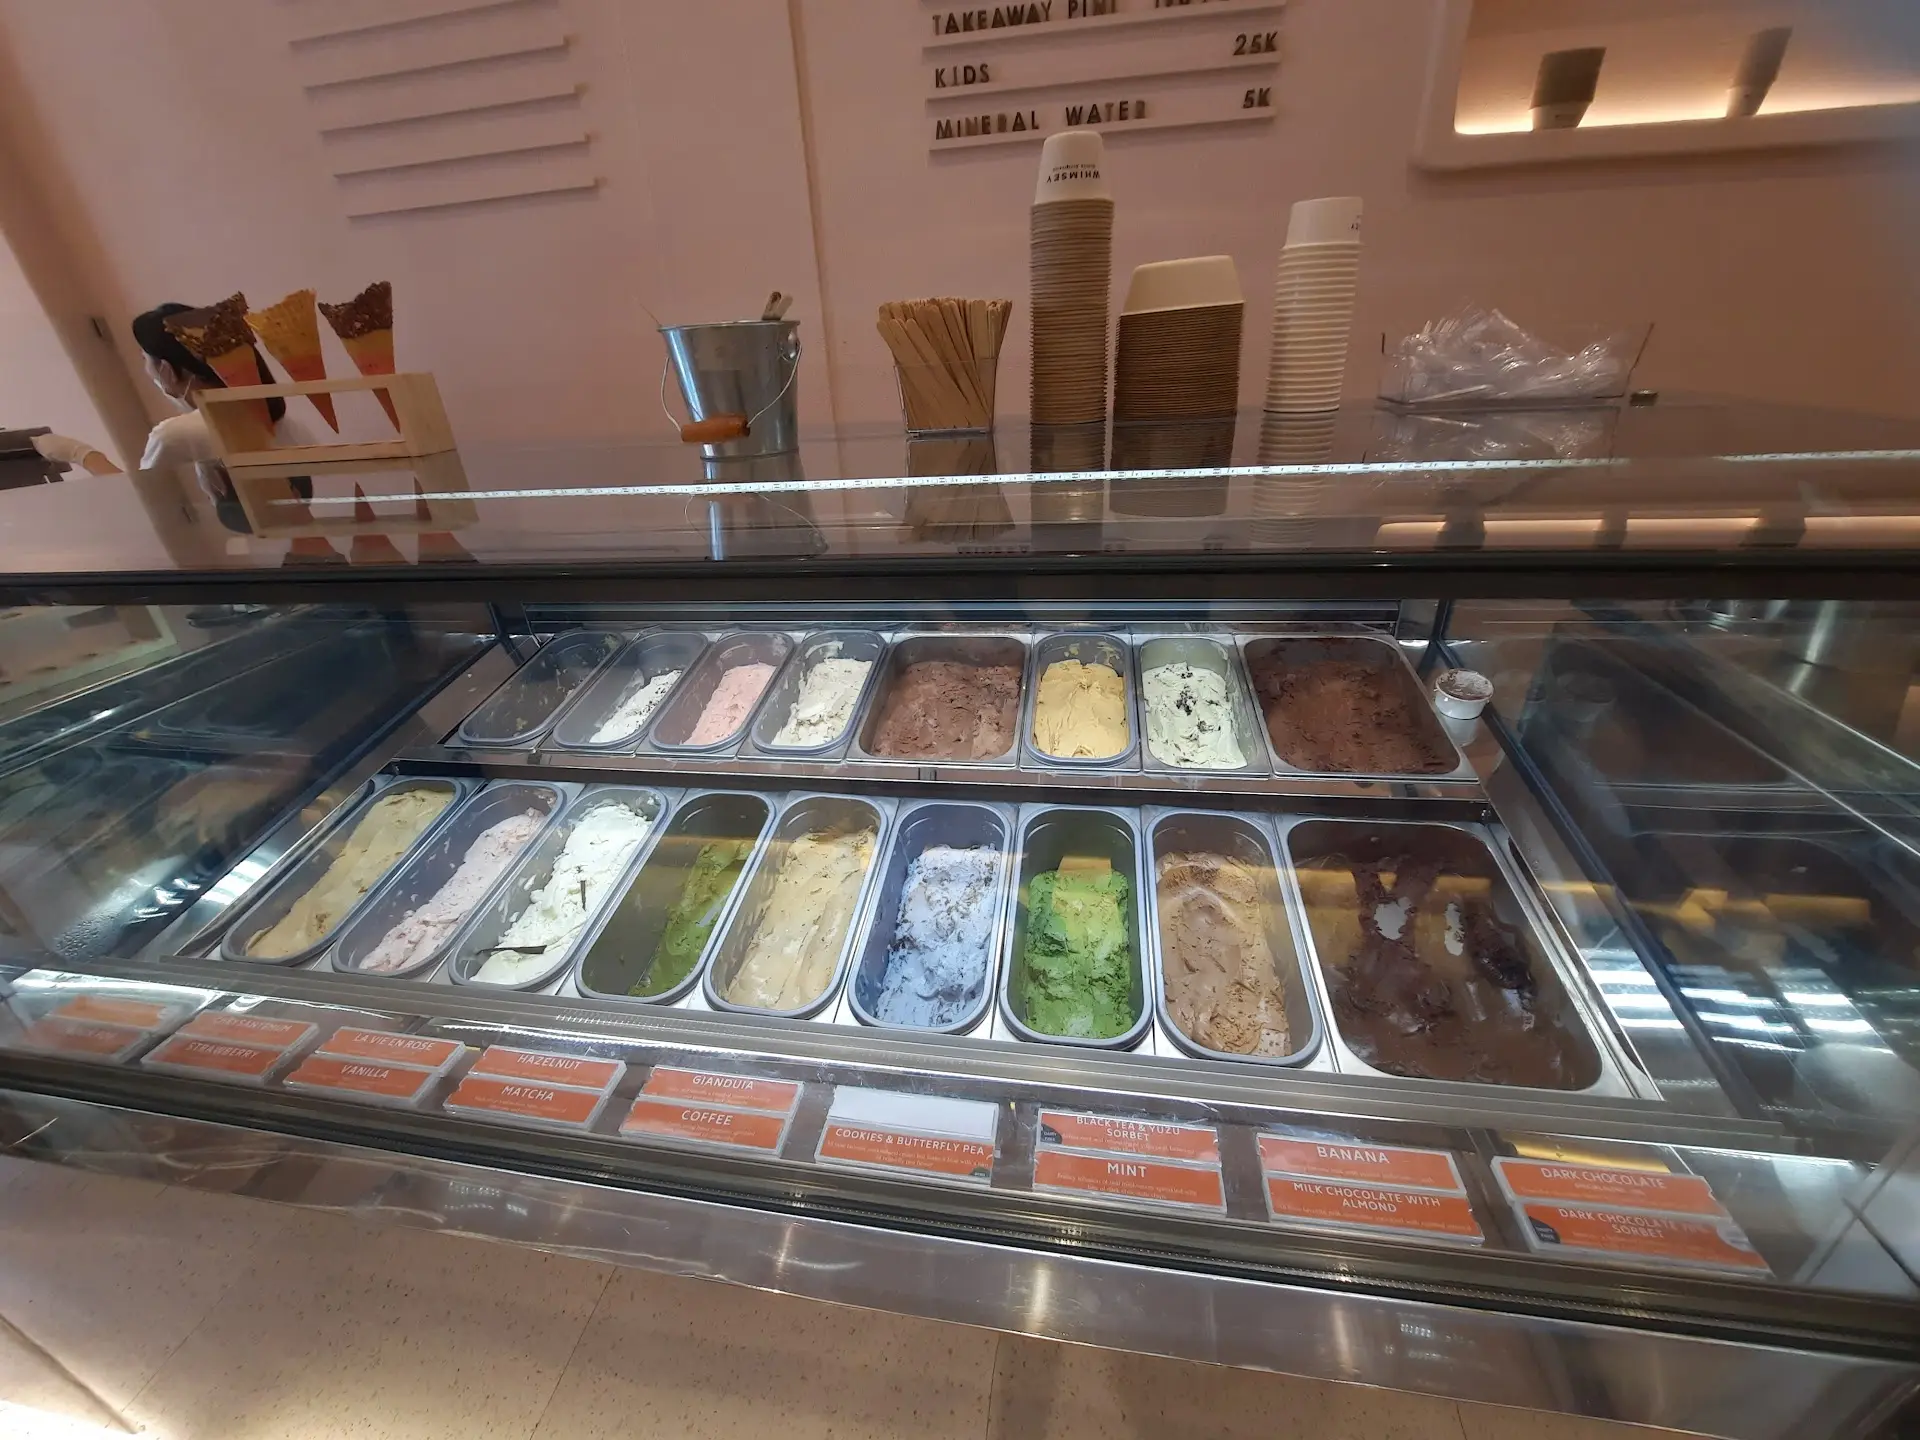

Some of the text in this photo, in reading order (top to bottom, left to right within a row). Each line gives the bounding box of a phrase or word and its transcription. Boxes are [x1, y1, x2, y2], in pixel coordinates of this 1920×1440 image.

[932, 2, 1051, 36] TAKEAWAY
[1232, 31, 1278, 56] 25K
[935, 63, 990, 89] KIDS
[1242, 86, 1271, 109] 5K
[935, 99, 1146, 140] MINERAL WATER
[1046, 170, 1100, 183] WHIMSEY
[186, 1042, 258, 1059] STRAWBERRY
[354, 1032, 436, 1052] LA VIE EN ROSE
[340, 1064, 390, 1079] VANILLA
[517, 1053, 584, 1071] HAZELNUT
[692, 1074, 755, 1090] GIANDUIA
[501, 1084, 556, 1101] MATCHA
[681, 1109, 734, 1127] COFFEE
[1076, 1116, 1181, 1136] BLACK TEA & YUZU
[835, 1127, 885, 1144] COOKIES
[885, 1134, 895, 1145] &
[896, 1135, 961, 1152] BUTTERFLY
[962, 1144, 985, 1156] PEA
[1107, 1128, 1151, 1142] SORBET
[1316, 1145, 1390, 1164] BANANA
[1107, 1162, 1148, 1178] MINT
[1541, 1167, 1579, 1181] DARK
[1581, 1172, 1667, 1189] CHOCOLATE
[1293, 1182, 1441, 1207] MILK CHOCOLATE WITH
[1342, 1198, 1397, 1213] ALMOND
[1558, 1207, 1594, 1222] DARK
[1597, 1211, 1678, 1231] CHOCOLATE
